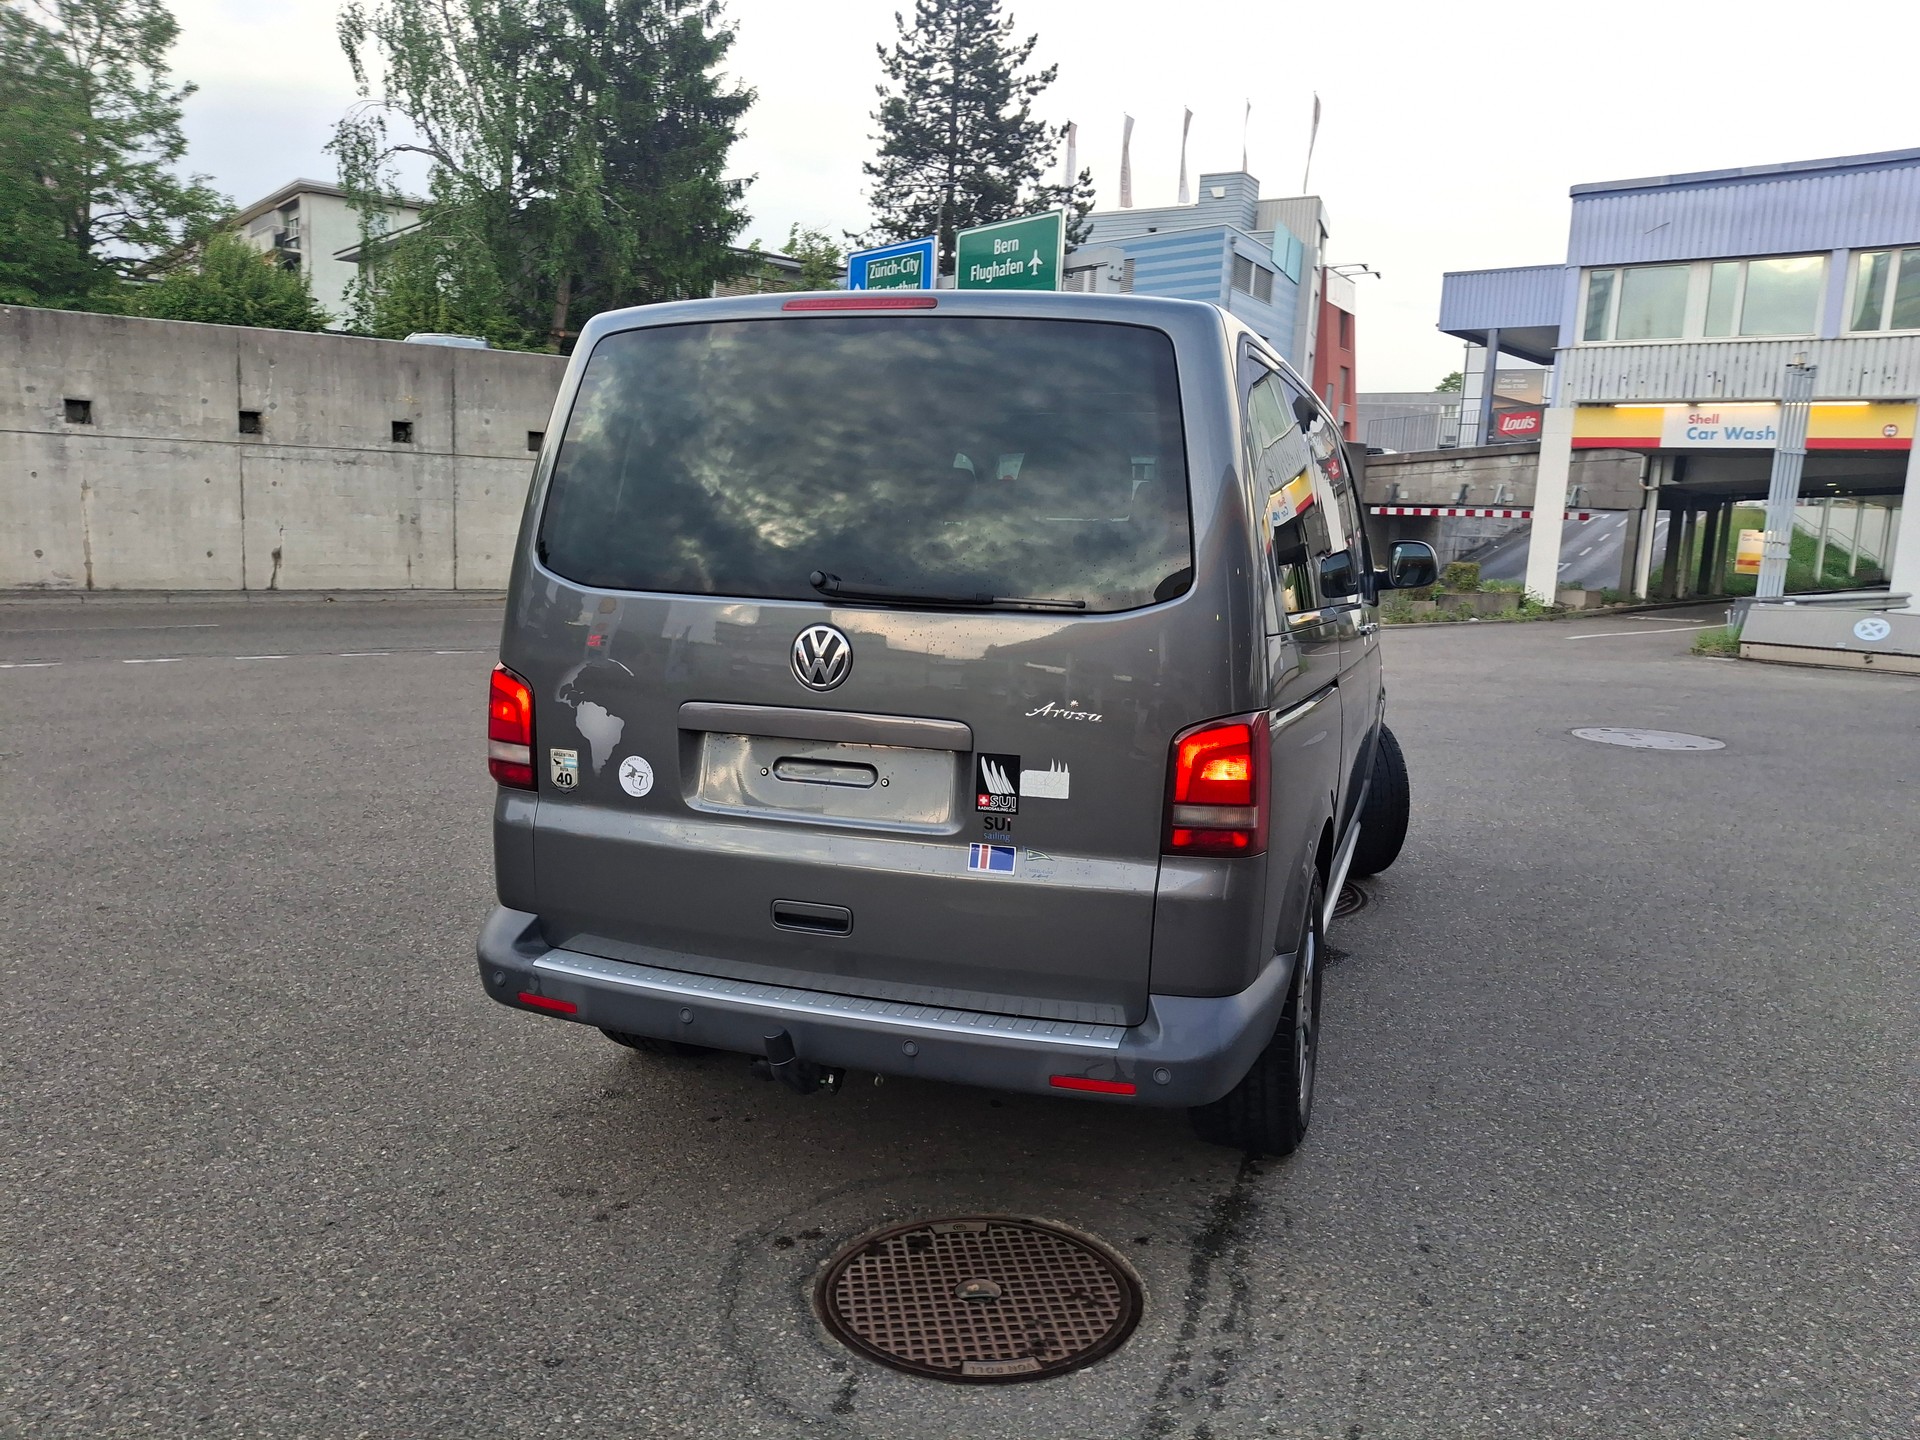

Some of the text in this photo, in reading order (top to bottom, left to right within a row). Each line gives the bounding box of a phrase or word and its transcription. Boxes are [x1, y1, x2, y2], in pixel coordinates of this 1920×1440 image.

[993, 239, 1019, 255] Bern
[869, 257, 920, 279] Zürich-City
[970, 258, 1024, 283] Flughafen
[1501, 415, 1537, 431] Louis
[1687, 414, 1719, 424] Shell
[1686, 425, 1777, 440] Car Wash
[557, 772, 572, 785] 40
[638, 775, 644, 786] 7
[990, 795, 1017, 809] SUI
[983, 832, 1010, 842] sailing
